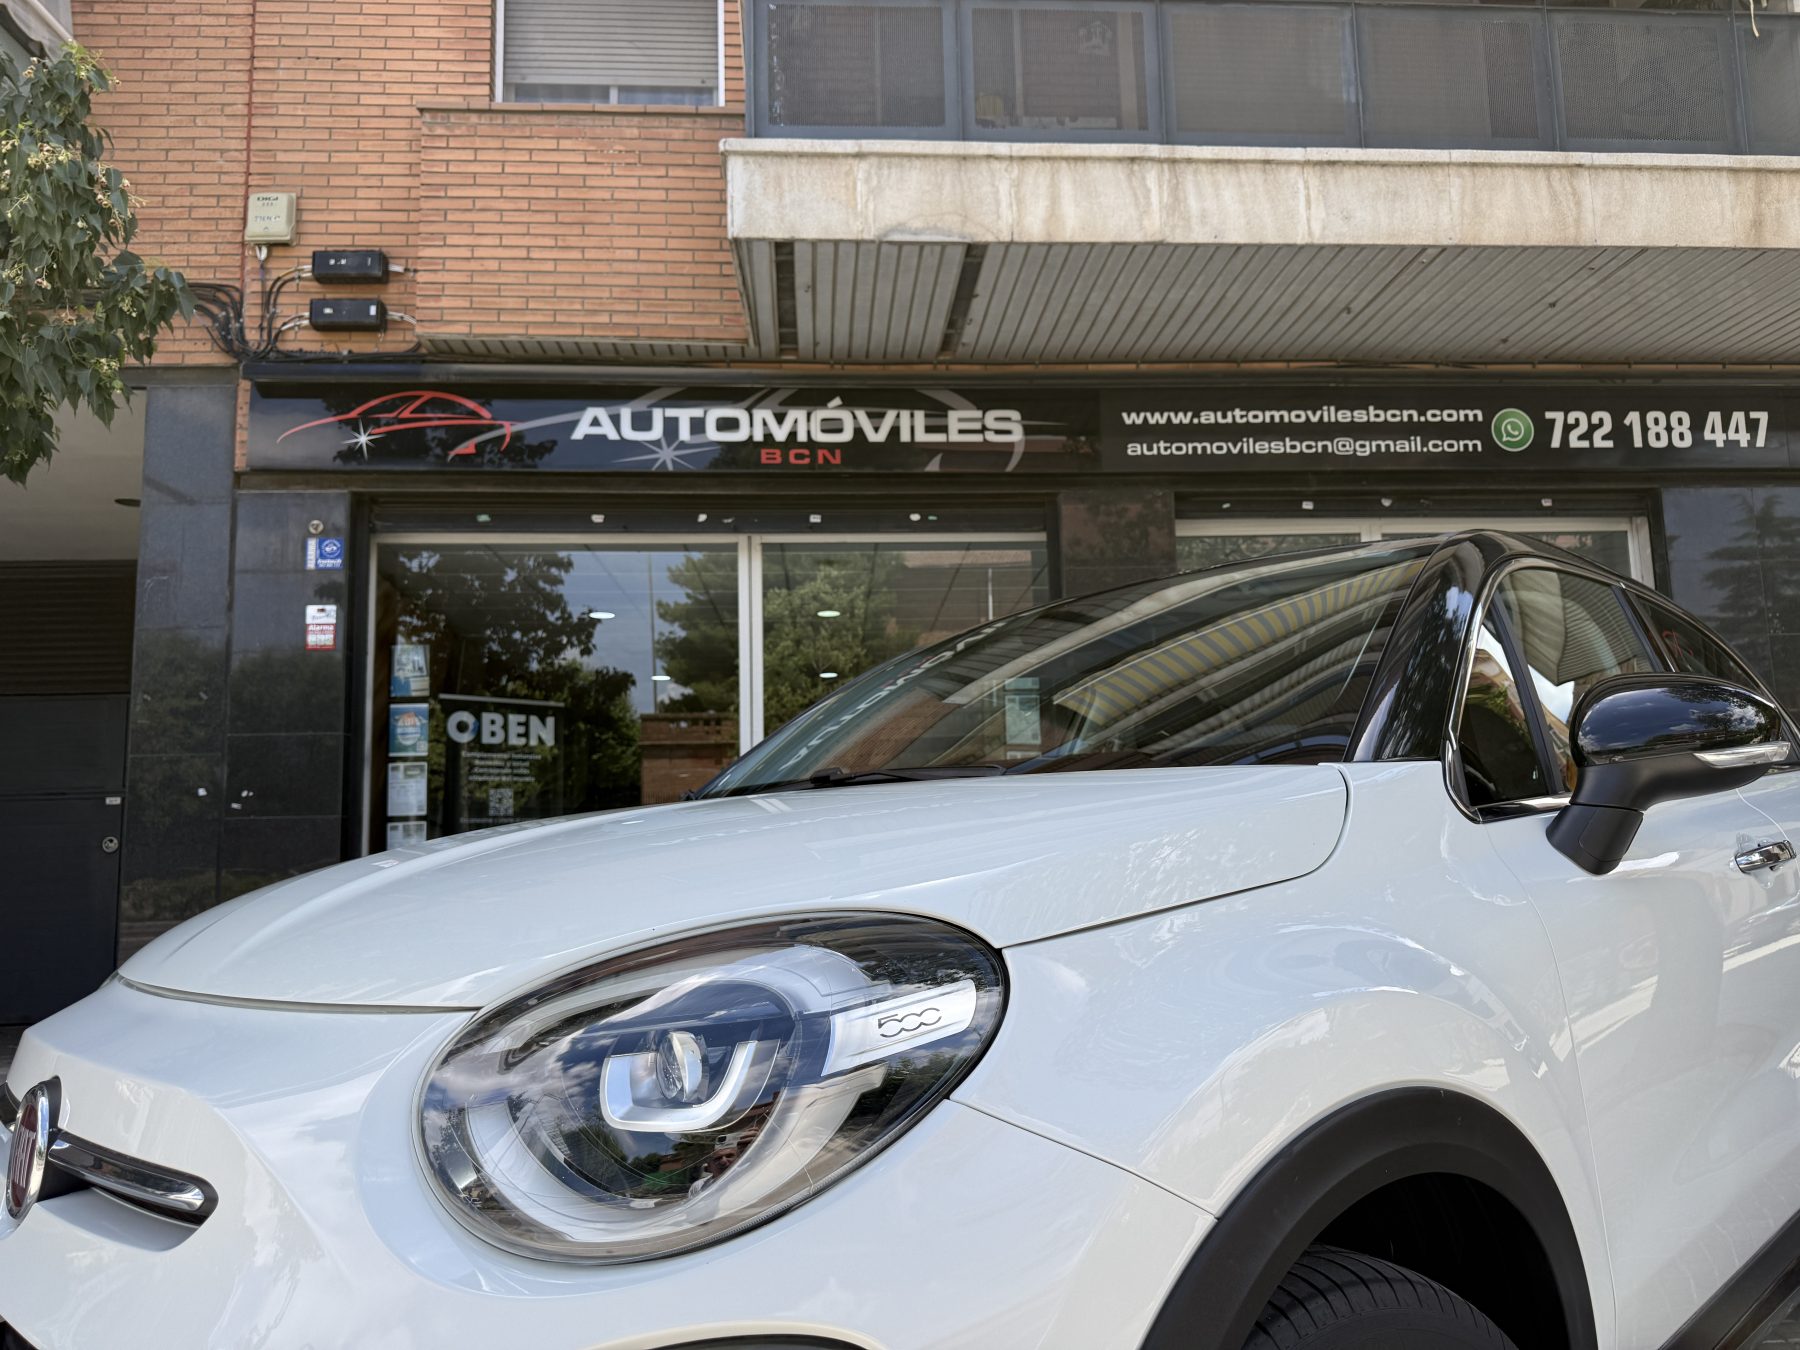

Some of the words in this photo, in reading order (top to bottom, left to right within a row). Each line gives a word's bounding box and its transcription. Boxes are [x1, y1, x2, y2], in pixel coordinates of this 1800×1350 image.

[570, 395, 1023, 443] AUTOMÓVILES
[1121, 405, 1483, 425] www.automovilesbcn.com
[1544, 410, 1614, 449] 722
[1623, 410, 1693, 448] 188
[1703, 410, 1769, 448] 447
[760, 448, 842, 465] BCN
[1126, 436, 1482, 456] automovilesbcn@gmail.com
[446, 710, 556, 747] OBEN
[877, 1007, 942, 1038] 500
